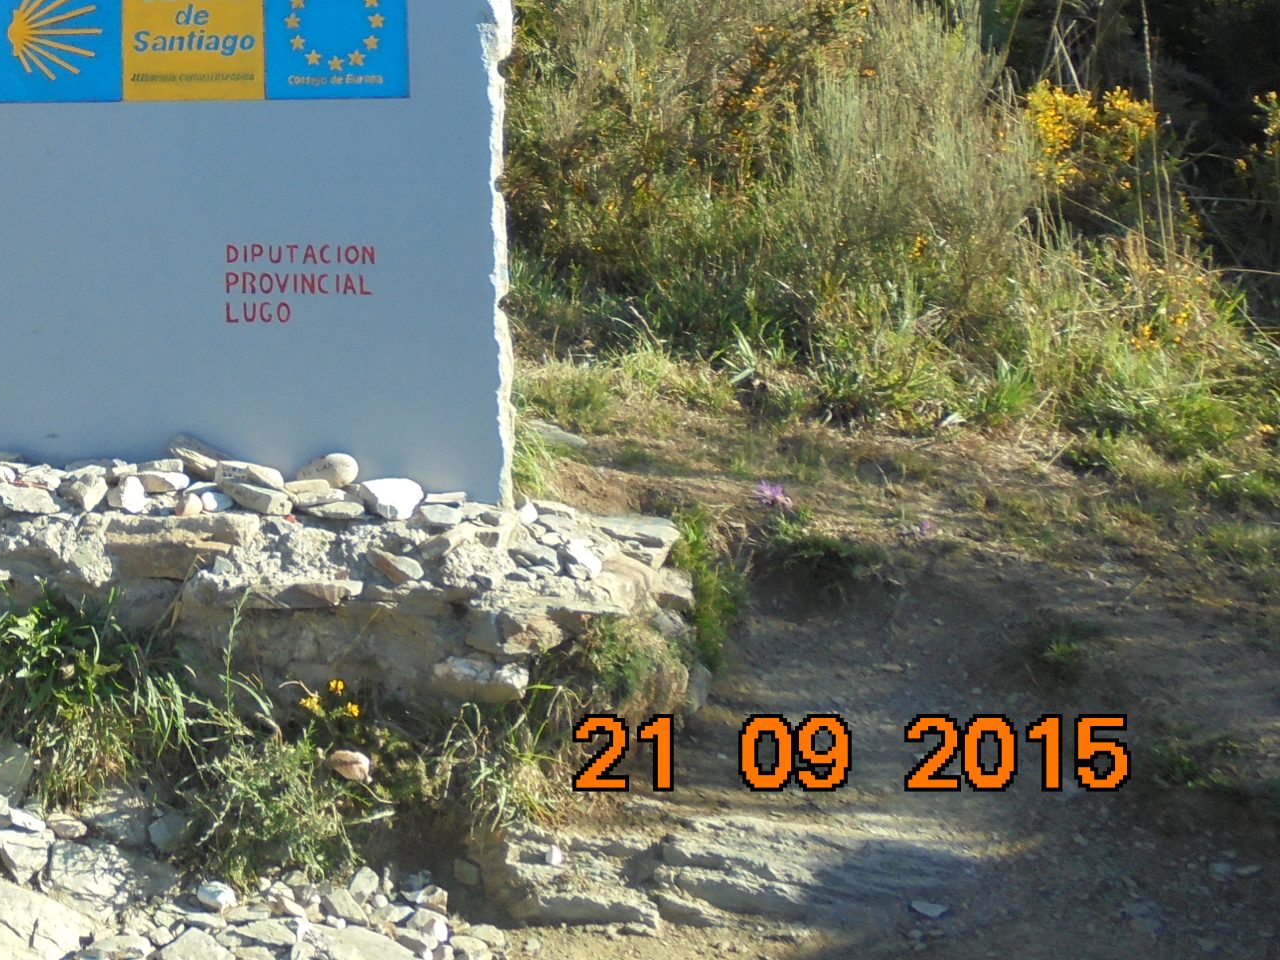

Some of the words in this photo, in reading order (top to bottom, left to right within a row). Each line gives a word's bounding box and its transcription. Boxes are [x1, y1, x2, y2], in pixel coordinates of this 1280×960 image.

[175, 3, 210, 26] de
[133, 29, 256, 56] Santiago
[226, 243, 376, 265] DIPUTACION
[225, 271, 374, 296] PROVINCIAL
[225, 301, 292, 324] LUGO
